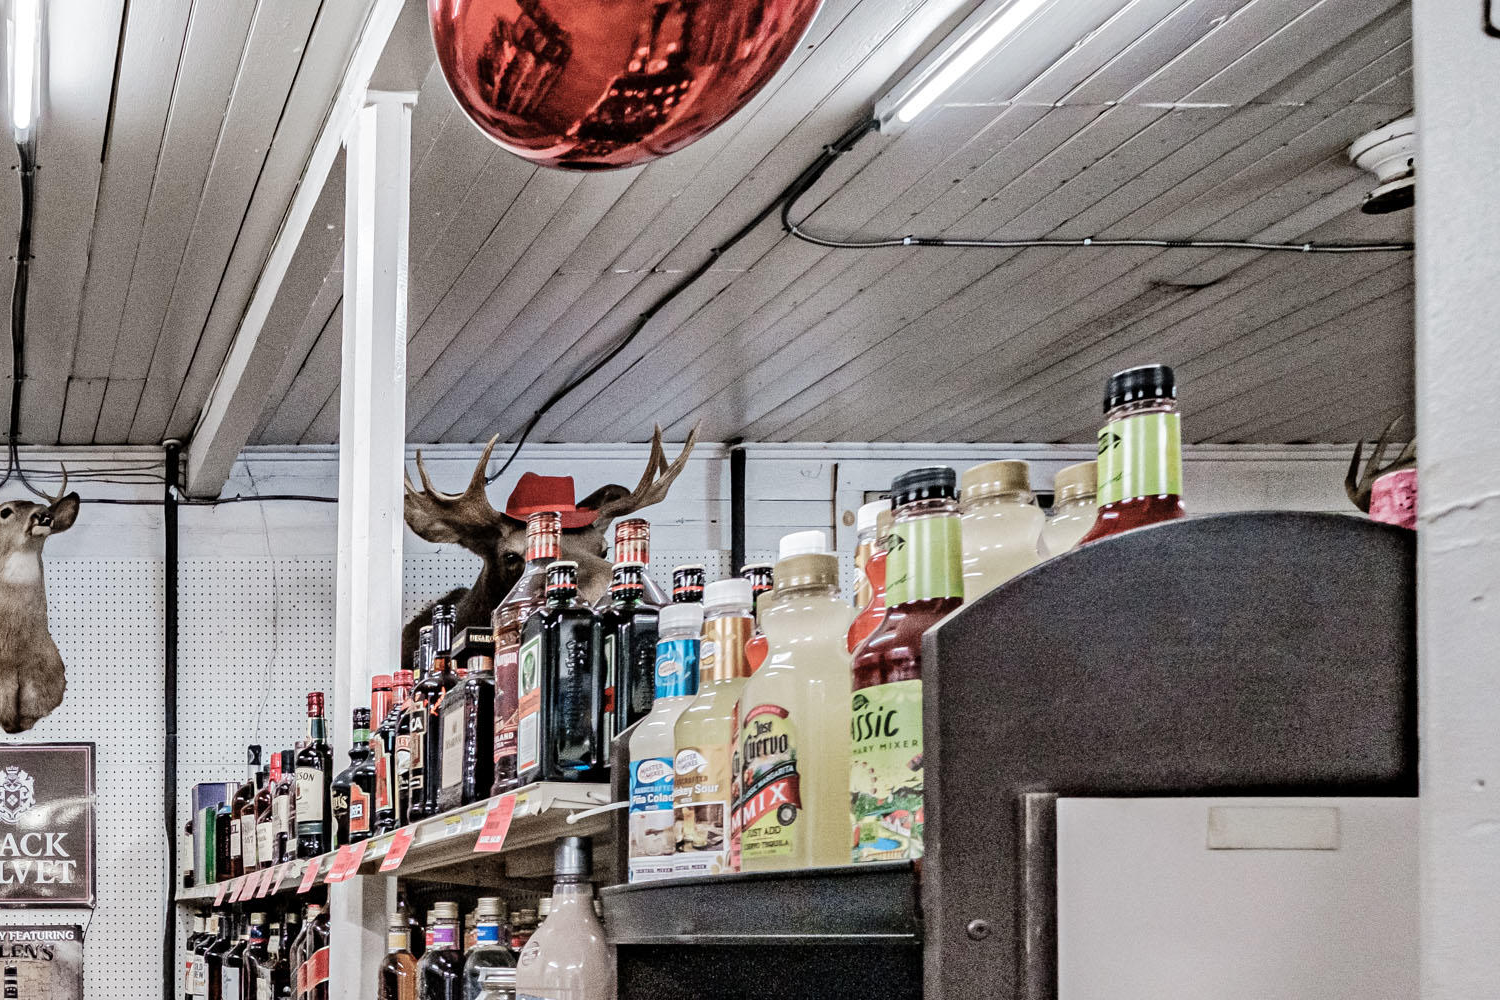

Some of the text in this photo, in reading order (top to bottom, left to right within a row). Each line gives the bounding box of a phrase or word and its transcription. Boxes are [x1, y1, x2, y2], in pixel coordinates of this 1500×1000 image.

[753, 720, 773, 738] Jose
[879, 739, 918, 750] MIXER
[694, 783, 719, 794] Sour
[743, 782, 788, 826] MIX
[10, 930, 74, 941] FEATURING
